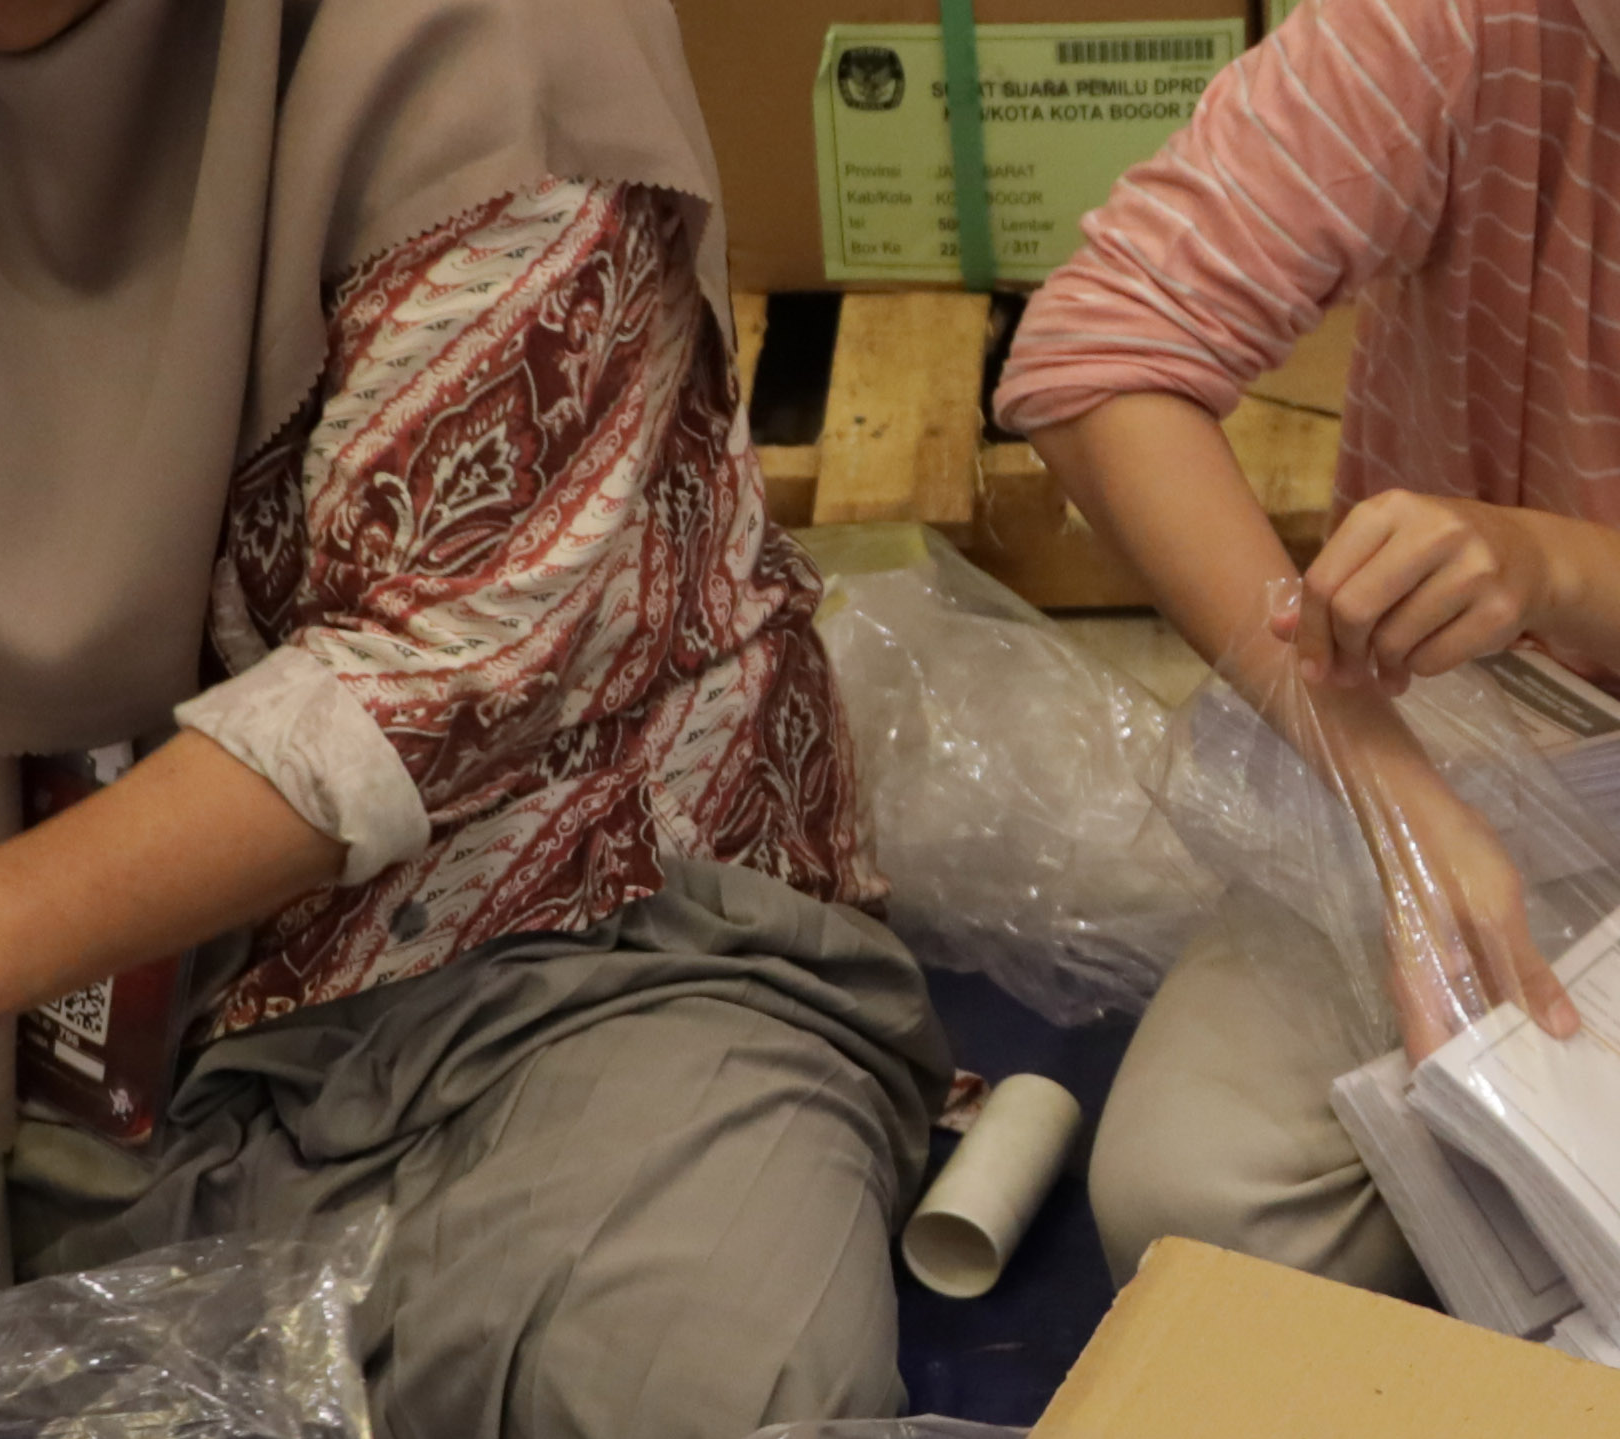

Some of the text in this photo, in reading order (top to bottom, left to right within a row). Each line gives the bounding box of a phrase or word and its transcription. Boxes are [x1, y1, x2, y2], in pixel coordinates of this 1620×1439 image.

[1003, 78, 1207, 98] SUARA PEMILU DPRD
[1050, 103, 1178, 121] KOTA BOGOR
